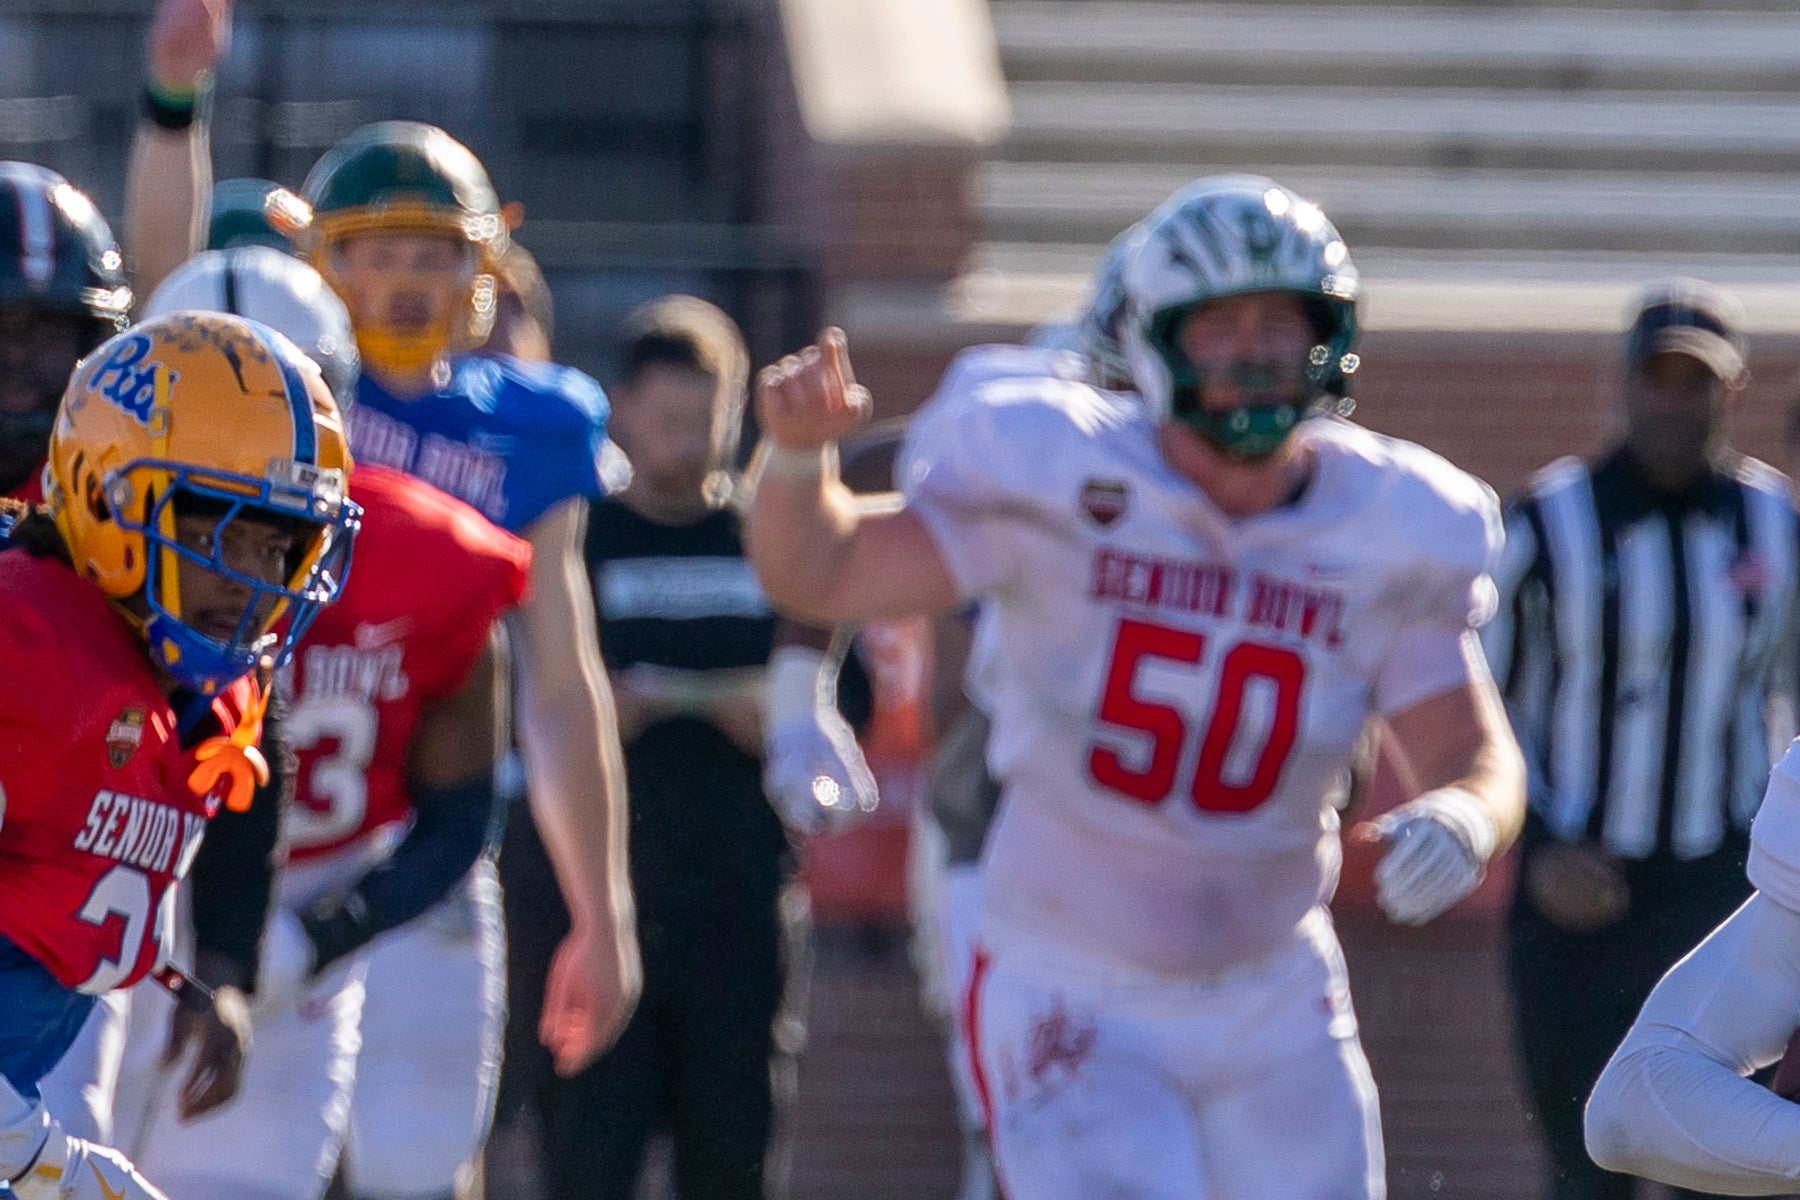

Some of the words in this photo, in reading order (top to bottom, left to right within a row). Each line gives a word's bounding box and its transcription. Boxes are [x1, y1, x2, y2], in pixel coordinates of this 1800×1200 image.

[1090, 547, 1238, 619] SENIOR
[1246, 571, 1343, 648] BOWL
[1088, 616, 1307, 815] 50
[73, 788, 180, 874] SENIOR
